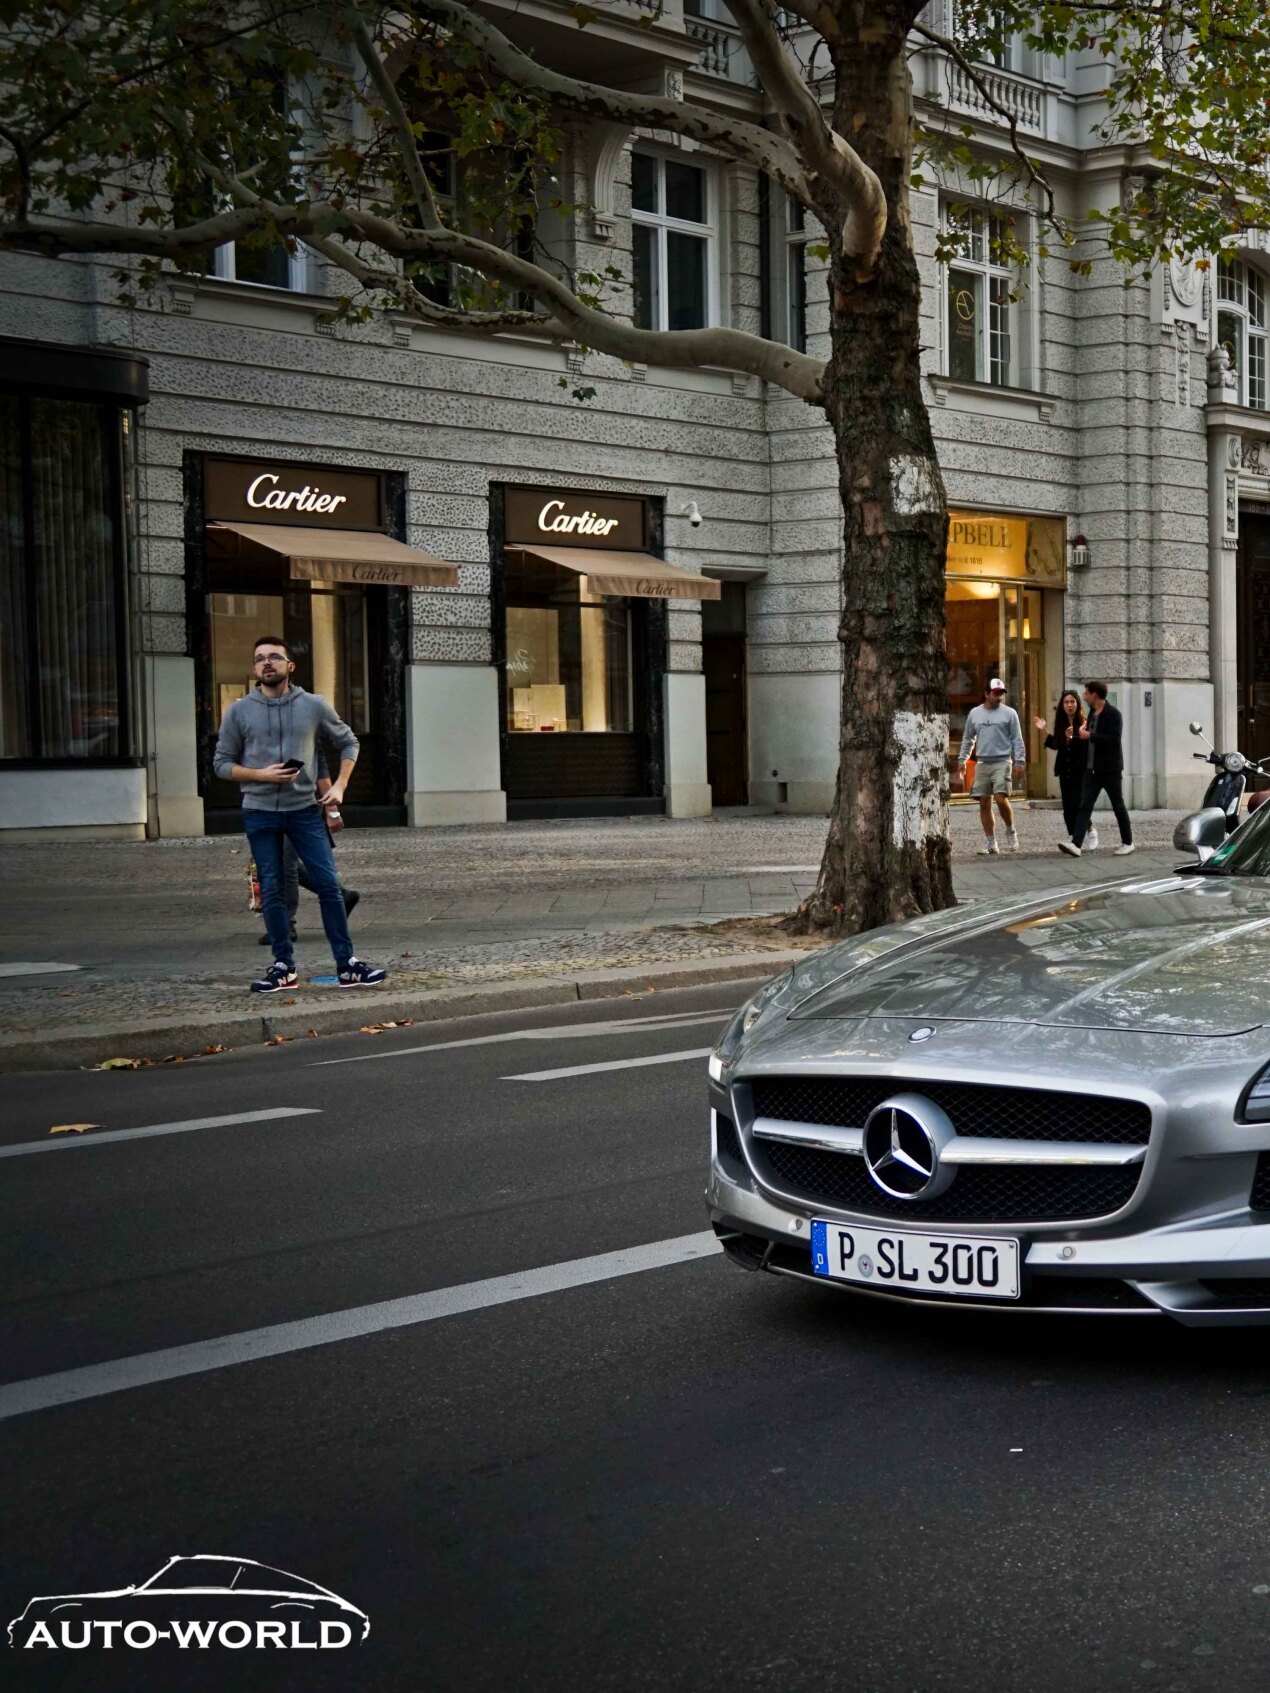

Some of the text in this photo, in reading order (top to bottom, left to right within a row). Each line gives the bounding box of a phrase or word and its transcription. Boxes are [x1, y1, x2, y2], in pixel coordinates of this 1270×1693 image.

[247, 473, 347, 514] Cartier
[538, 500, 619, 536] Cartier
[952, 521, 1012, 549] PBELL
[352, 562, 402, 582] Cartier
[635, 578, 676, 596] Cartier
[838, 1231, 855, 1271] P
[877, 1238, 919, 1282] SL
[928, 1242, 999, 1287] 300
